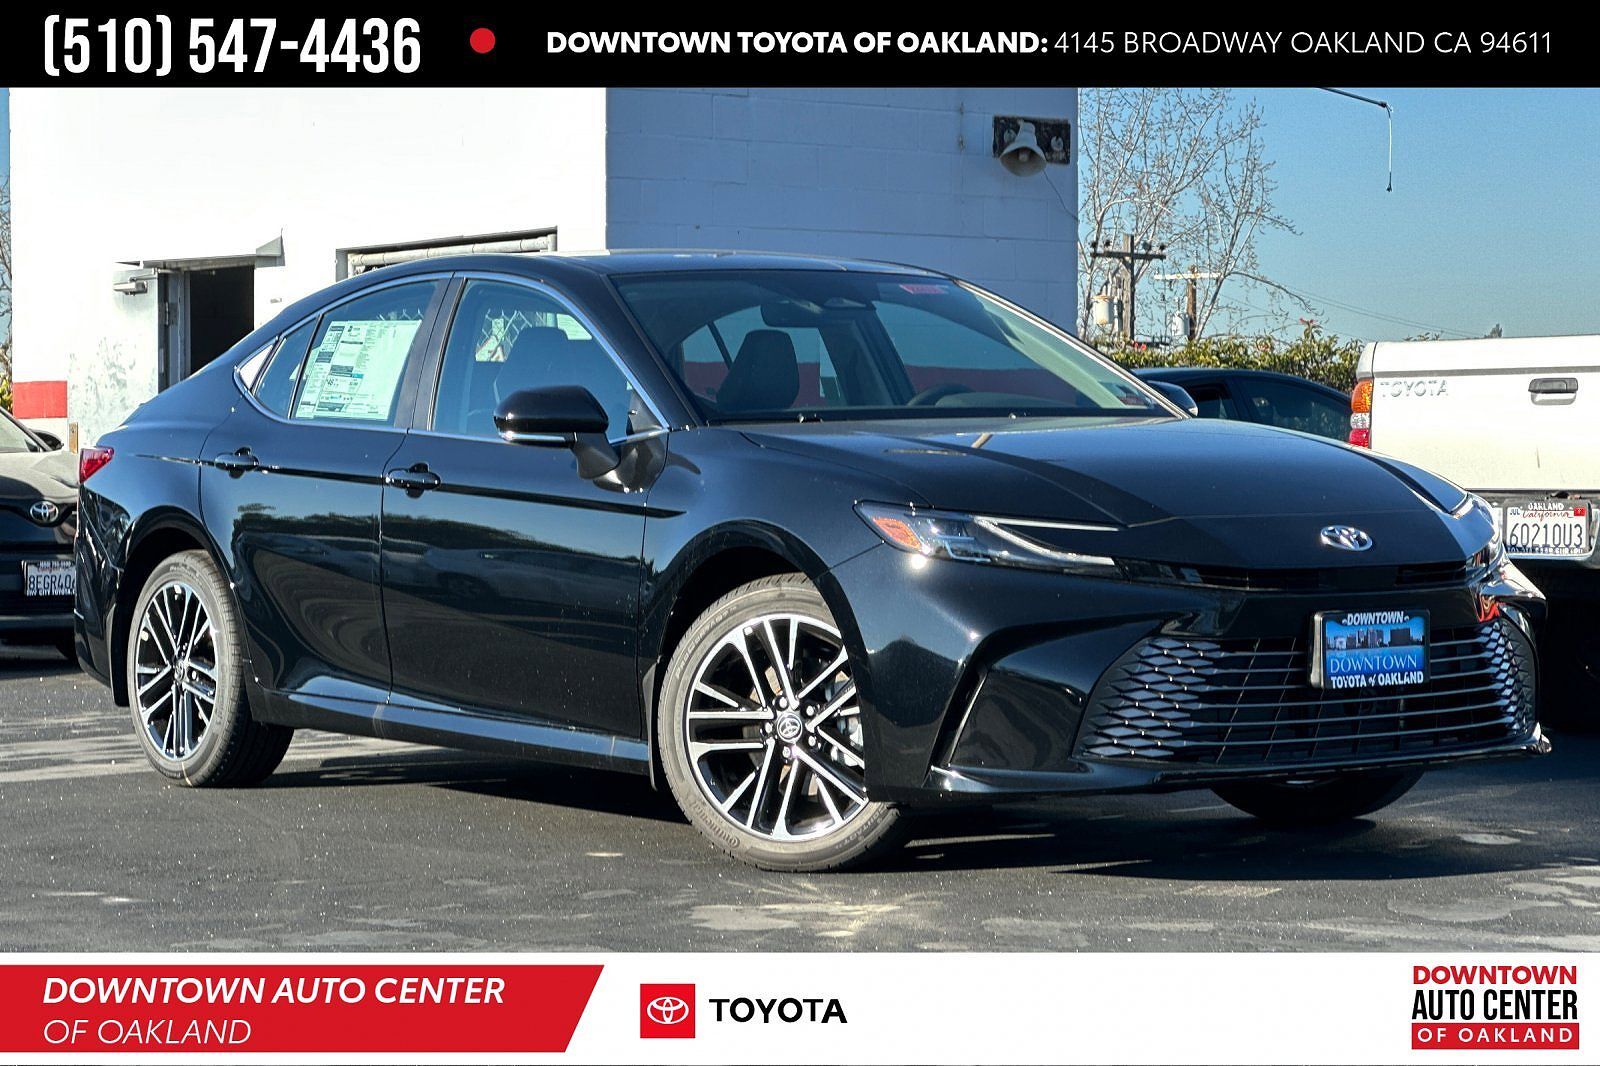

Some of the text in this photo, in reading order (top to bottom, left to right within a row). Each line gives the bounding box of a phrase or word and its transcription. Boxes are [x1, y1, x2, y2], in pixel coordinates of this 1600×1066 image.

[1380, 379, 1449, 398] TOYOTA
[1528, 502, 1564, 511] OAKLAND
[1522, 510, 1569, 521] California
[1347, 611, 1404, 626] DOWNTOWN
[1330, 654, 1417, 674] DOWNTOWN
[1331, 674, 1366, 689] TOYOTA
[1378, 671, 1424, 686] OAKLAND
